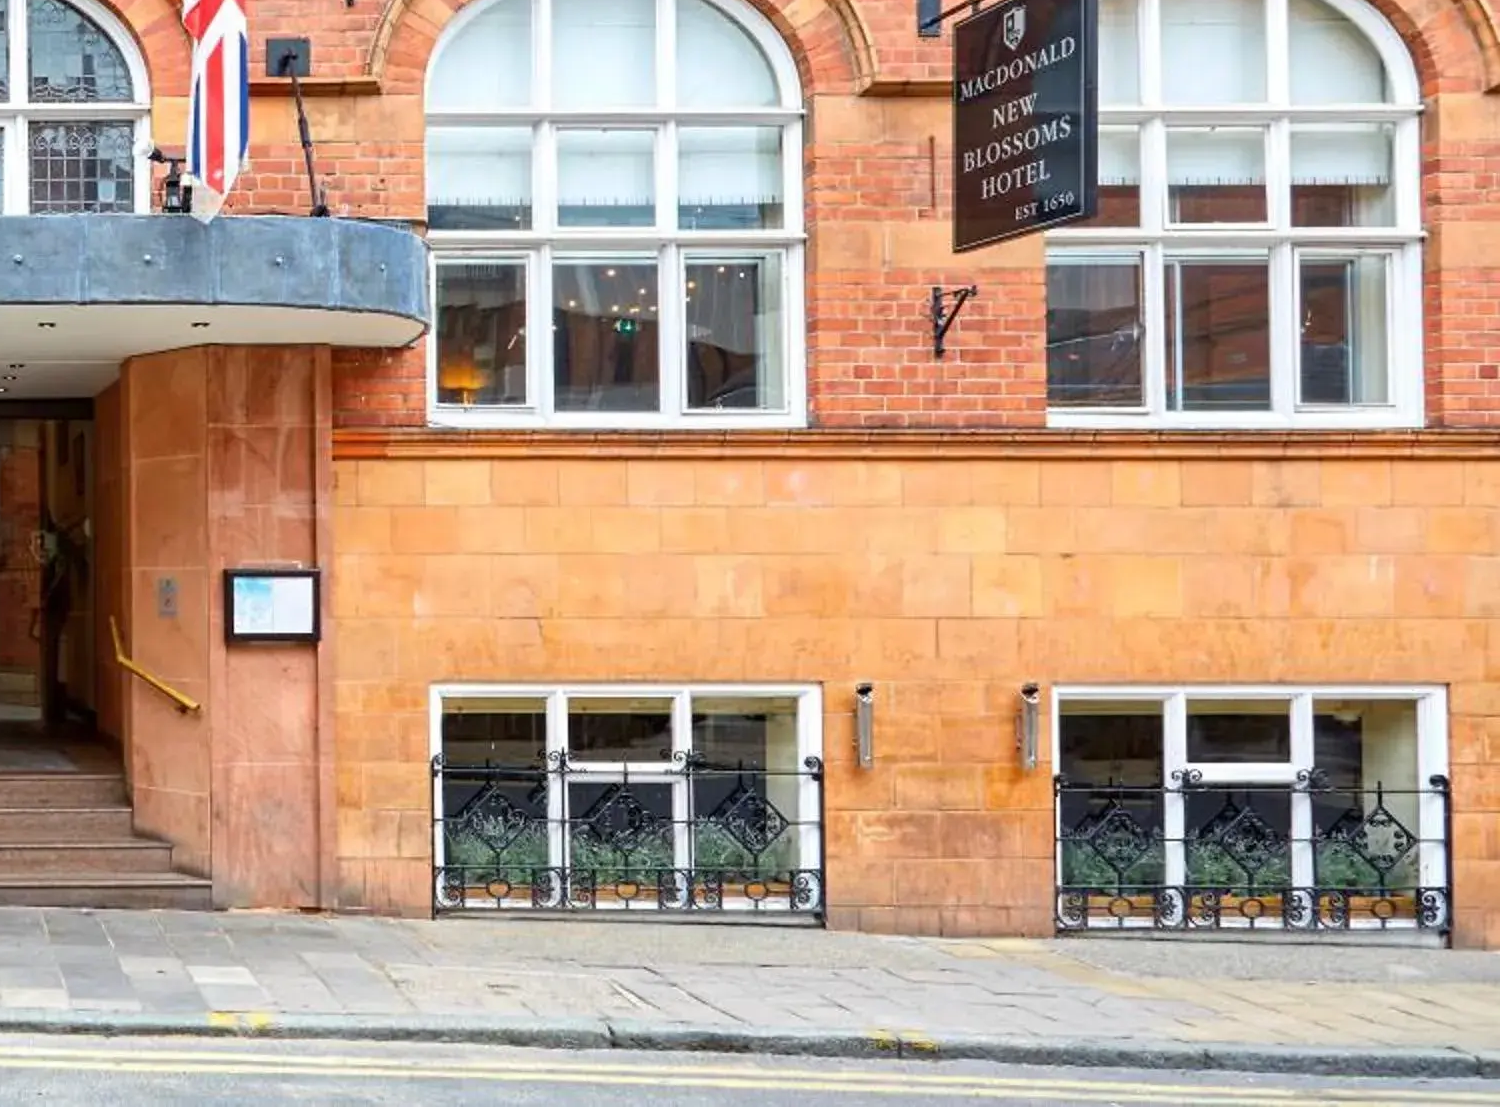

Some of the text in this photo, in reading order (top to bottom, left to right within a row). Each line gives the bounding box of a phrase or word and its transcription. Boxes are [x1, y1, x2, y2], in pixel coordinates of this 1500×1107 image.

[960, 36, 1076, 102] MACDONALD
[991, 92, 1038, 129] NEW
[963, 113, 1072, 173] BLOSSOMS
[980, 159, 1051, 200] HOTEL
[1015, 190, 1075, 221] EST 1650
